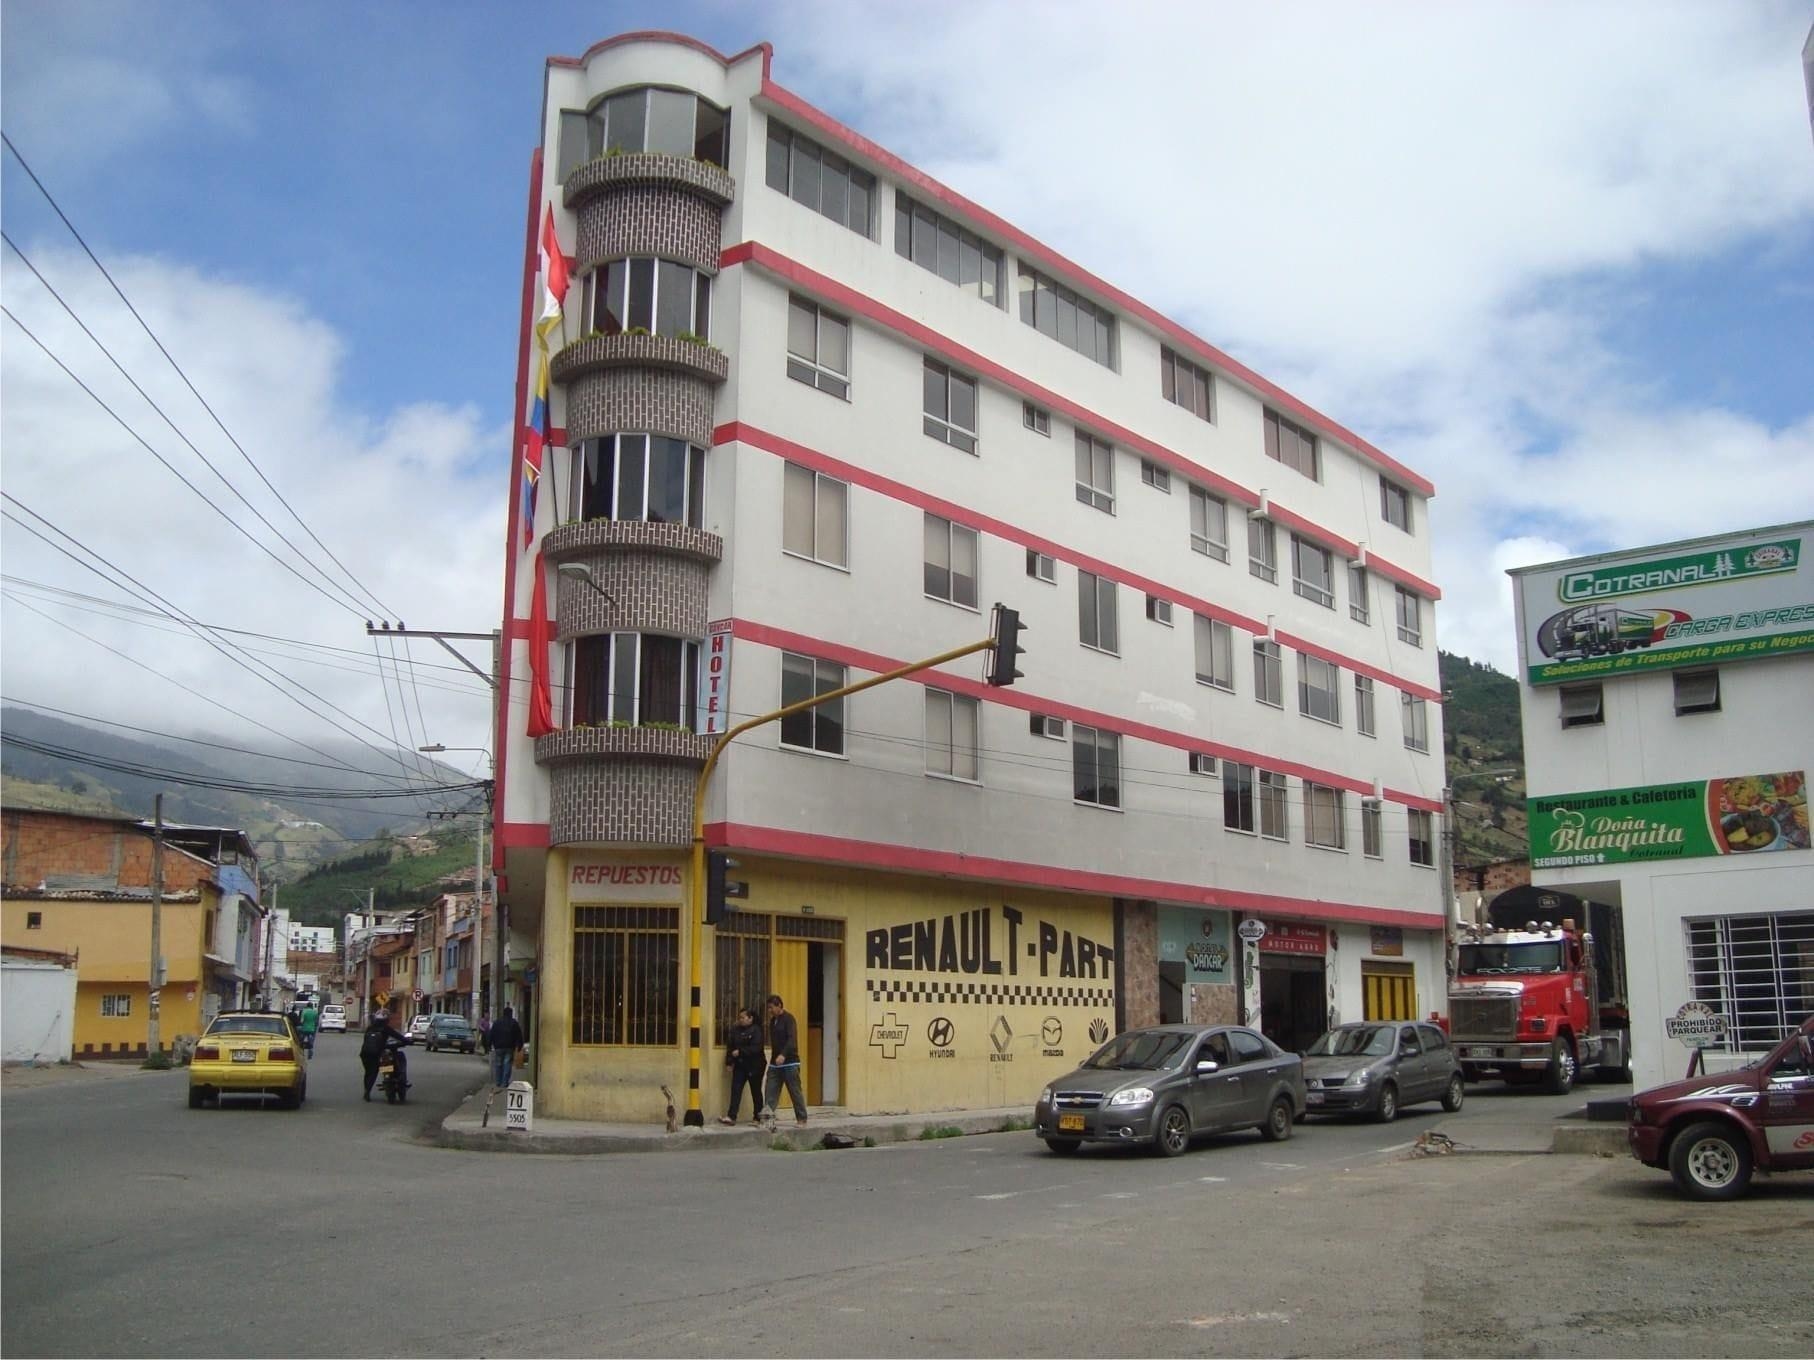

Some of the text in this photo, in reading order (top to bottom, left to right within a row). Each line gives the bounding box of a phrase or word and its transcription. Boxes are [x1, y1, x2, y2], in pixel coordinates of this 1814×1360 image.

[1566, 564, 1716, 598] COTRANAL
[1664, 614, 1734, 639] CARGA
[1542, 659, 1612, 677] Soluciones
[1616, 656, 1632, 667] de
[1636, 647, 1709, 665] Transporte
[1713, 643, 1745, 657] para
[1749, 641, 1766, 650] su
[707, 636, 724, 732] HOTEL
[1536, 794, 1617, 813] Restaurante
[1620, 793, 1630, 805] &
[1591, 816, 1647, 833] Doña
[1550, 822, 1685, 853] Blanquita
[1534, 854, 1595, 867] SEGUNDO PISO
[571, 864, 682, 885] REPUESTOS
[1671, 1018, 1721, 1028] PROHIBIDO
[1672, 1025, 1722, 1035] PARQUEAR
[929, 1049, 955, 1059] HYUNDAI
[509, 1092, 523, 1108] 70
